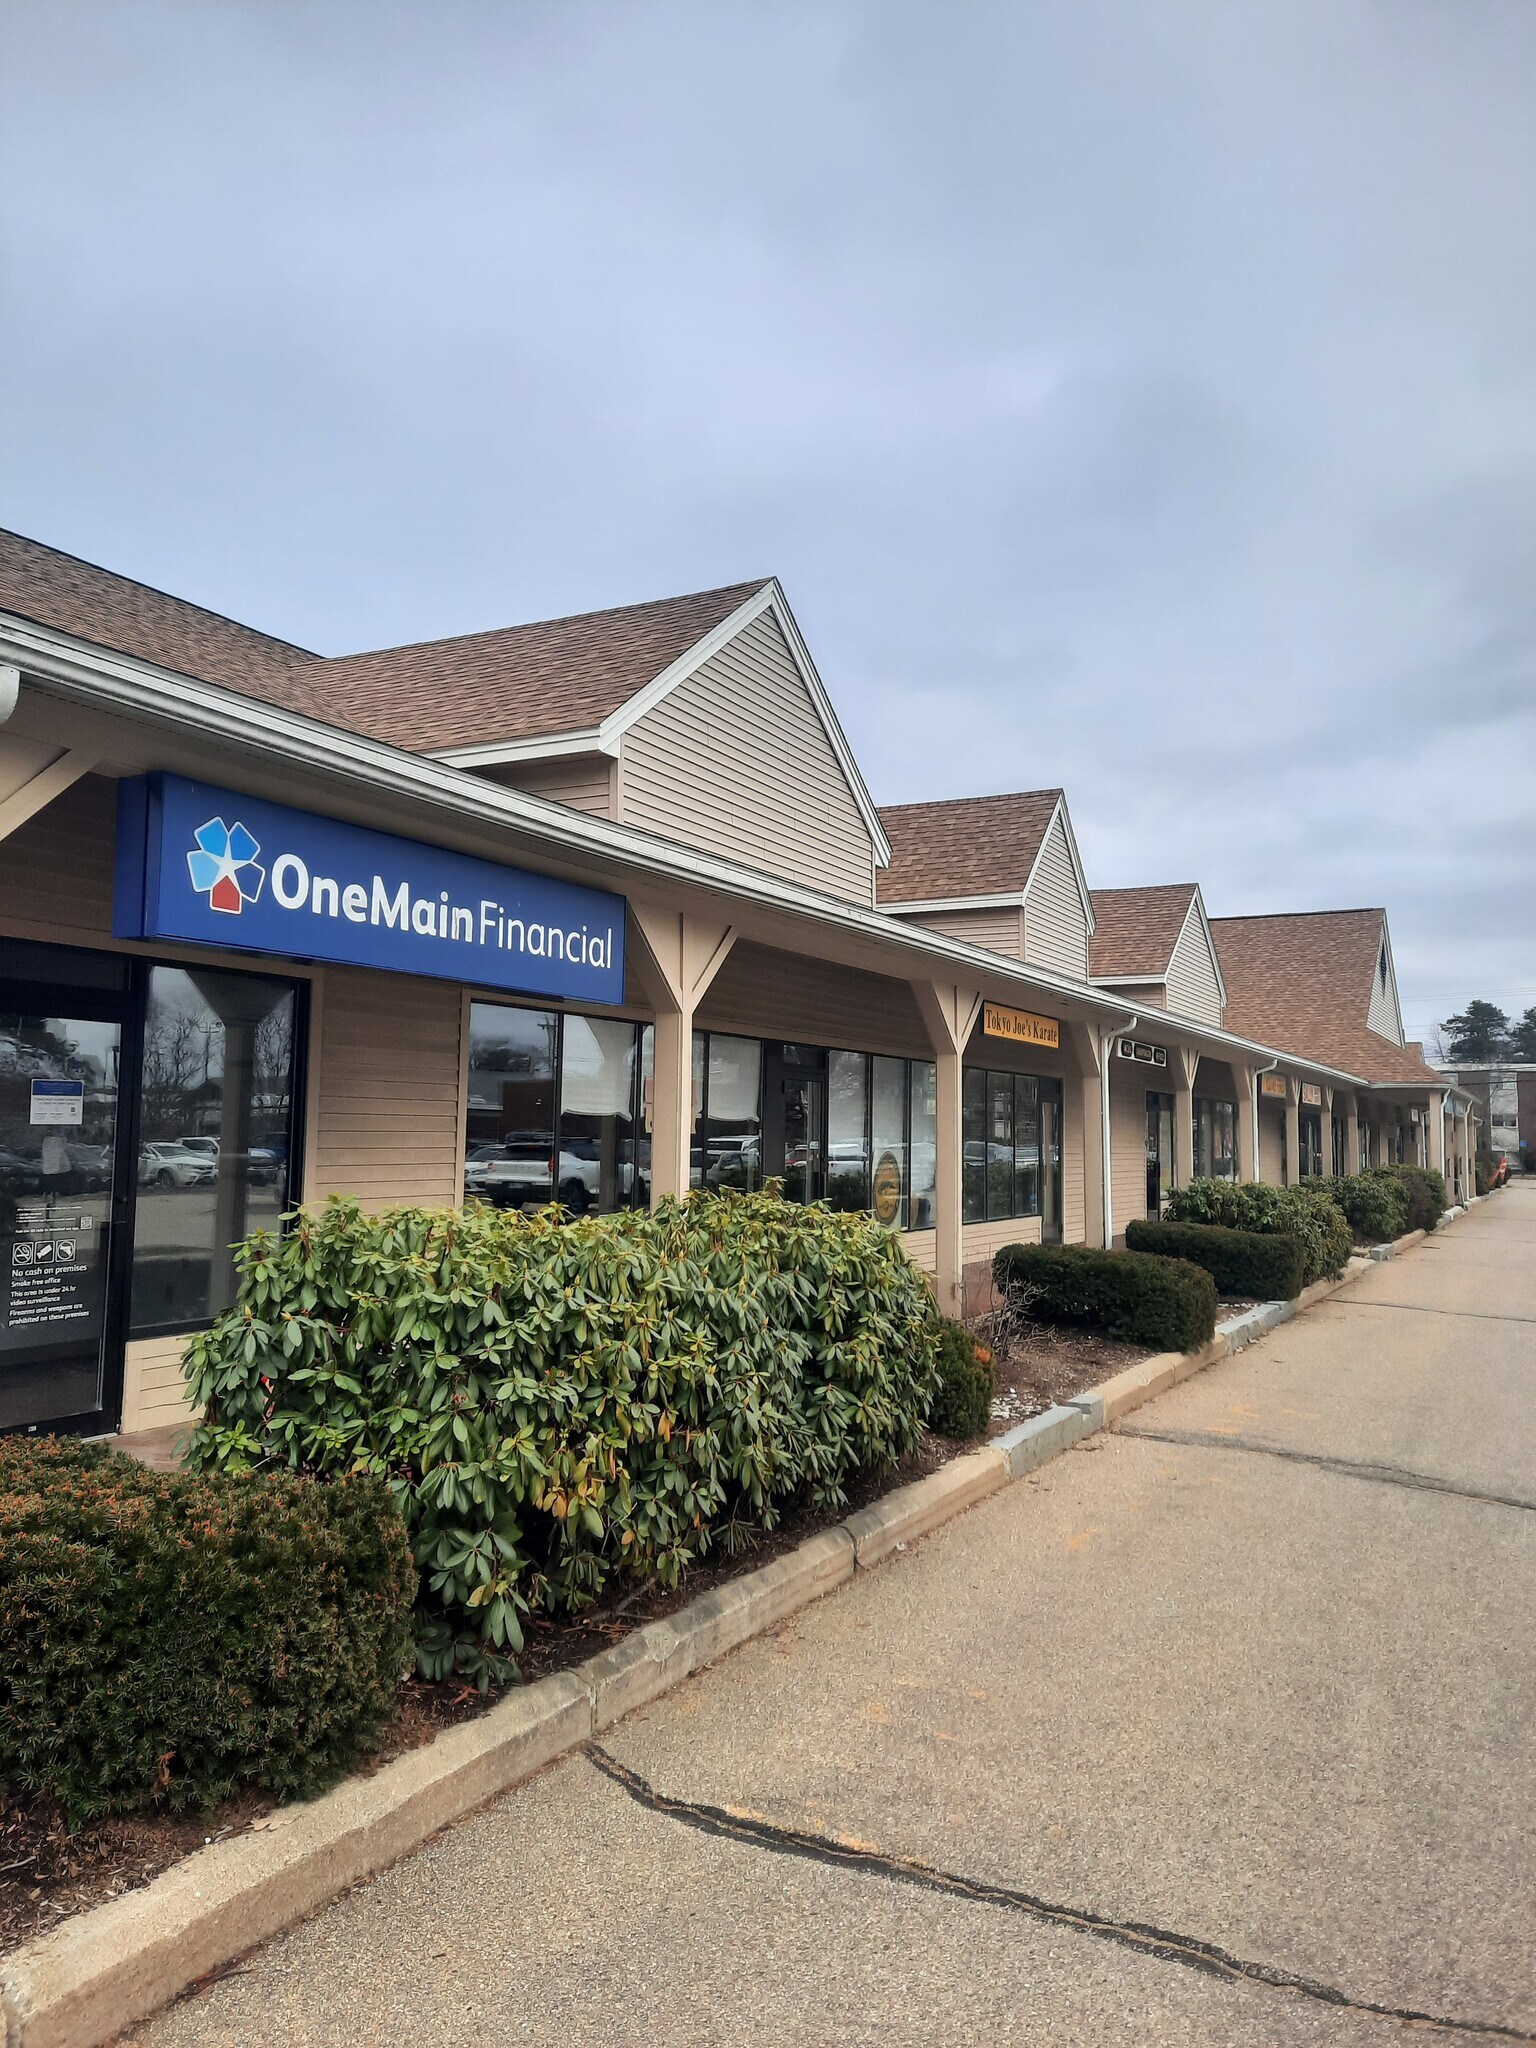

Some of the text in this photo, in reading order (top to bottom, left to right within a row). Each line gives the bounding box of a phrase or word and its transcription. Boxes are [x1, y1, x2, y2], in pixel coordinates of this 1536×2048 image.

[986, 1009, 1057, 1042] Tokyo Joe's Karate
[12, 1269, 23, 1278] No
[25, 1267, 42, 1276] cash
[55, 1264, 87, 1275] premises
[27, 1296, 60, 1304] surveillance
[9, 1308, 35, 1316] Firearms
[48, 1304, 72, 1312] weapons
[8, 1315, 39, 1327] prohibited
[65, 1311, 90, 1320] premises
